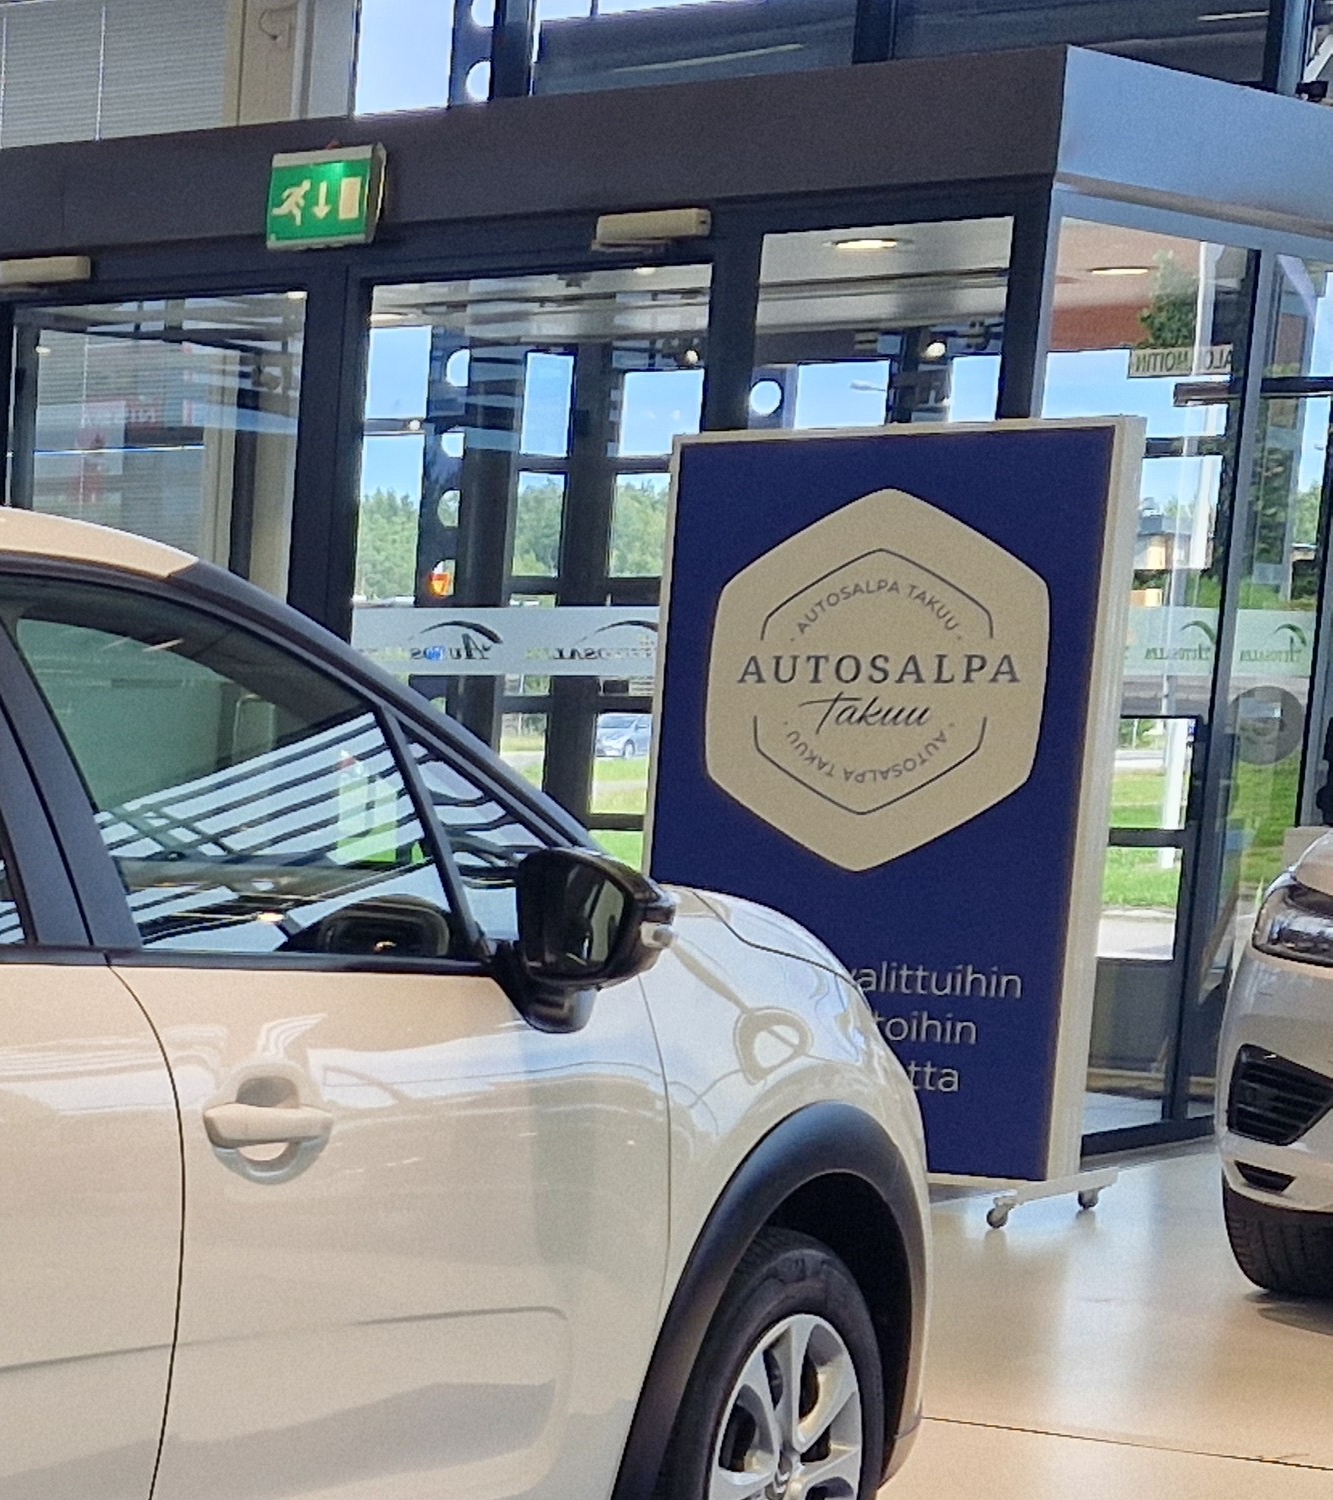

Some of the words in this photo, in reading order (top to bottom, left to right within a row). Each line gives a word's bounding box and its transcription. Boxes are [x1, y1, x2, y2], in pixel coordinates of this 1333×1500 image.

[796, 579, 901, 635] AUTOSALPA
[907, 583, 961, 632] TAKUU
[736, 653, 1022, 685] AUTOSALPA
[798, 691, 932, 735] Takuu
[785, 730, 836, 778] TAKUU
[843, 730, 948, 784] AUTOSALPA
[851, 960, 1023, 999] alittuihin
[907, 1060, 960, 1092] tta
